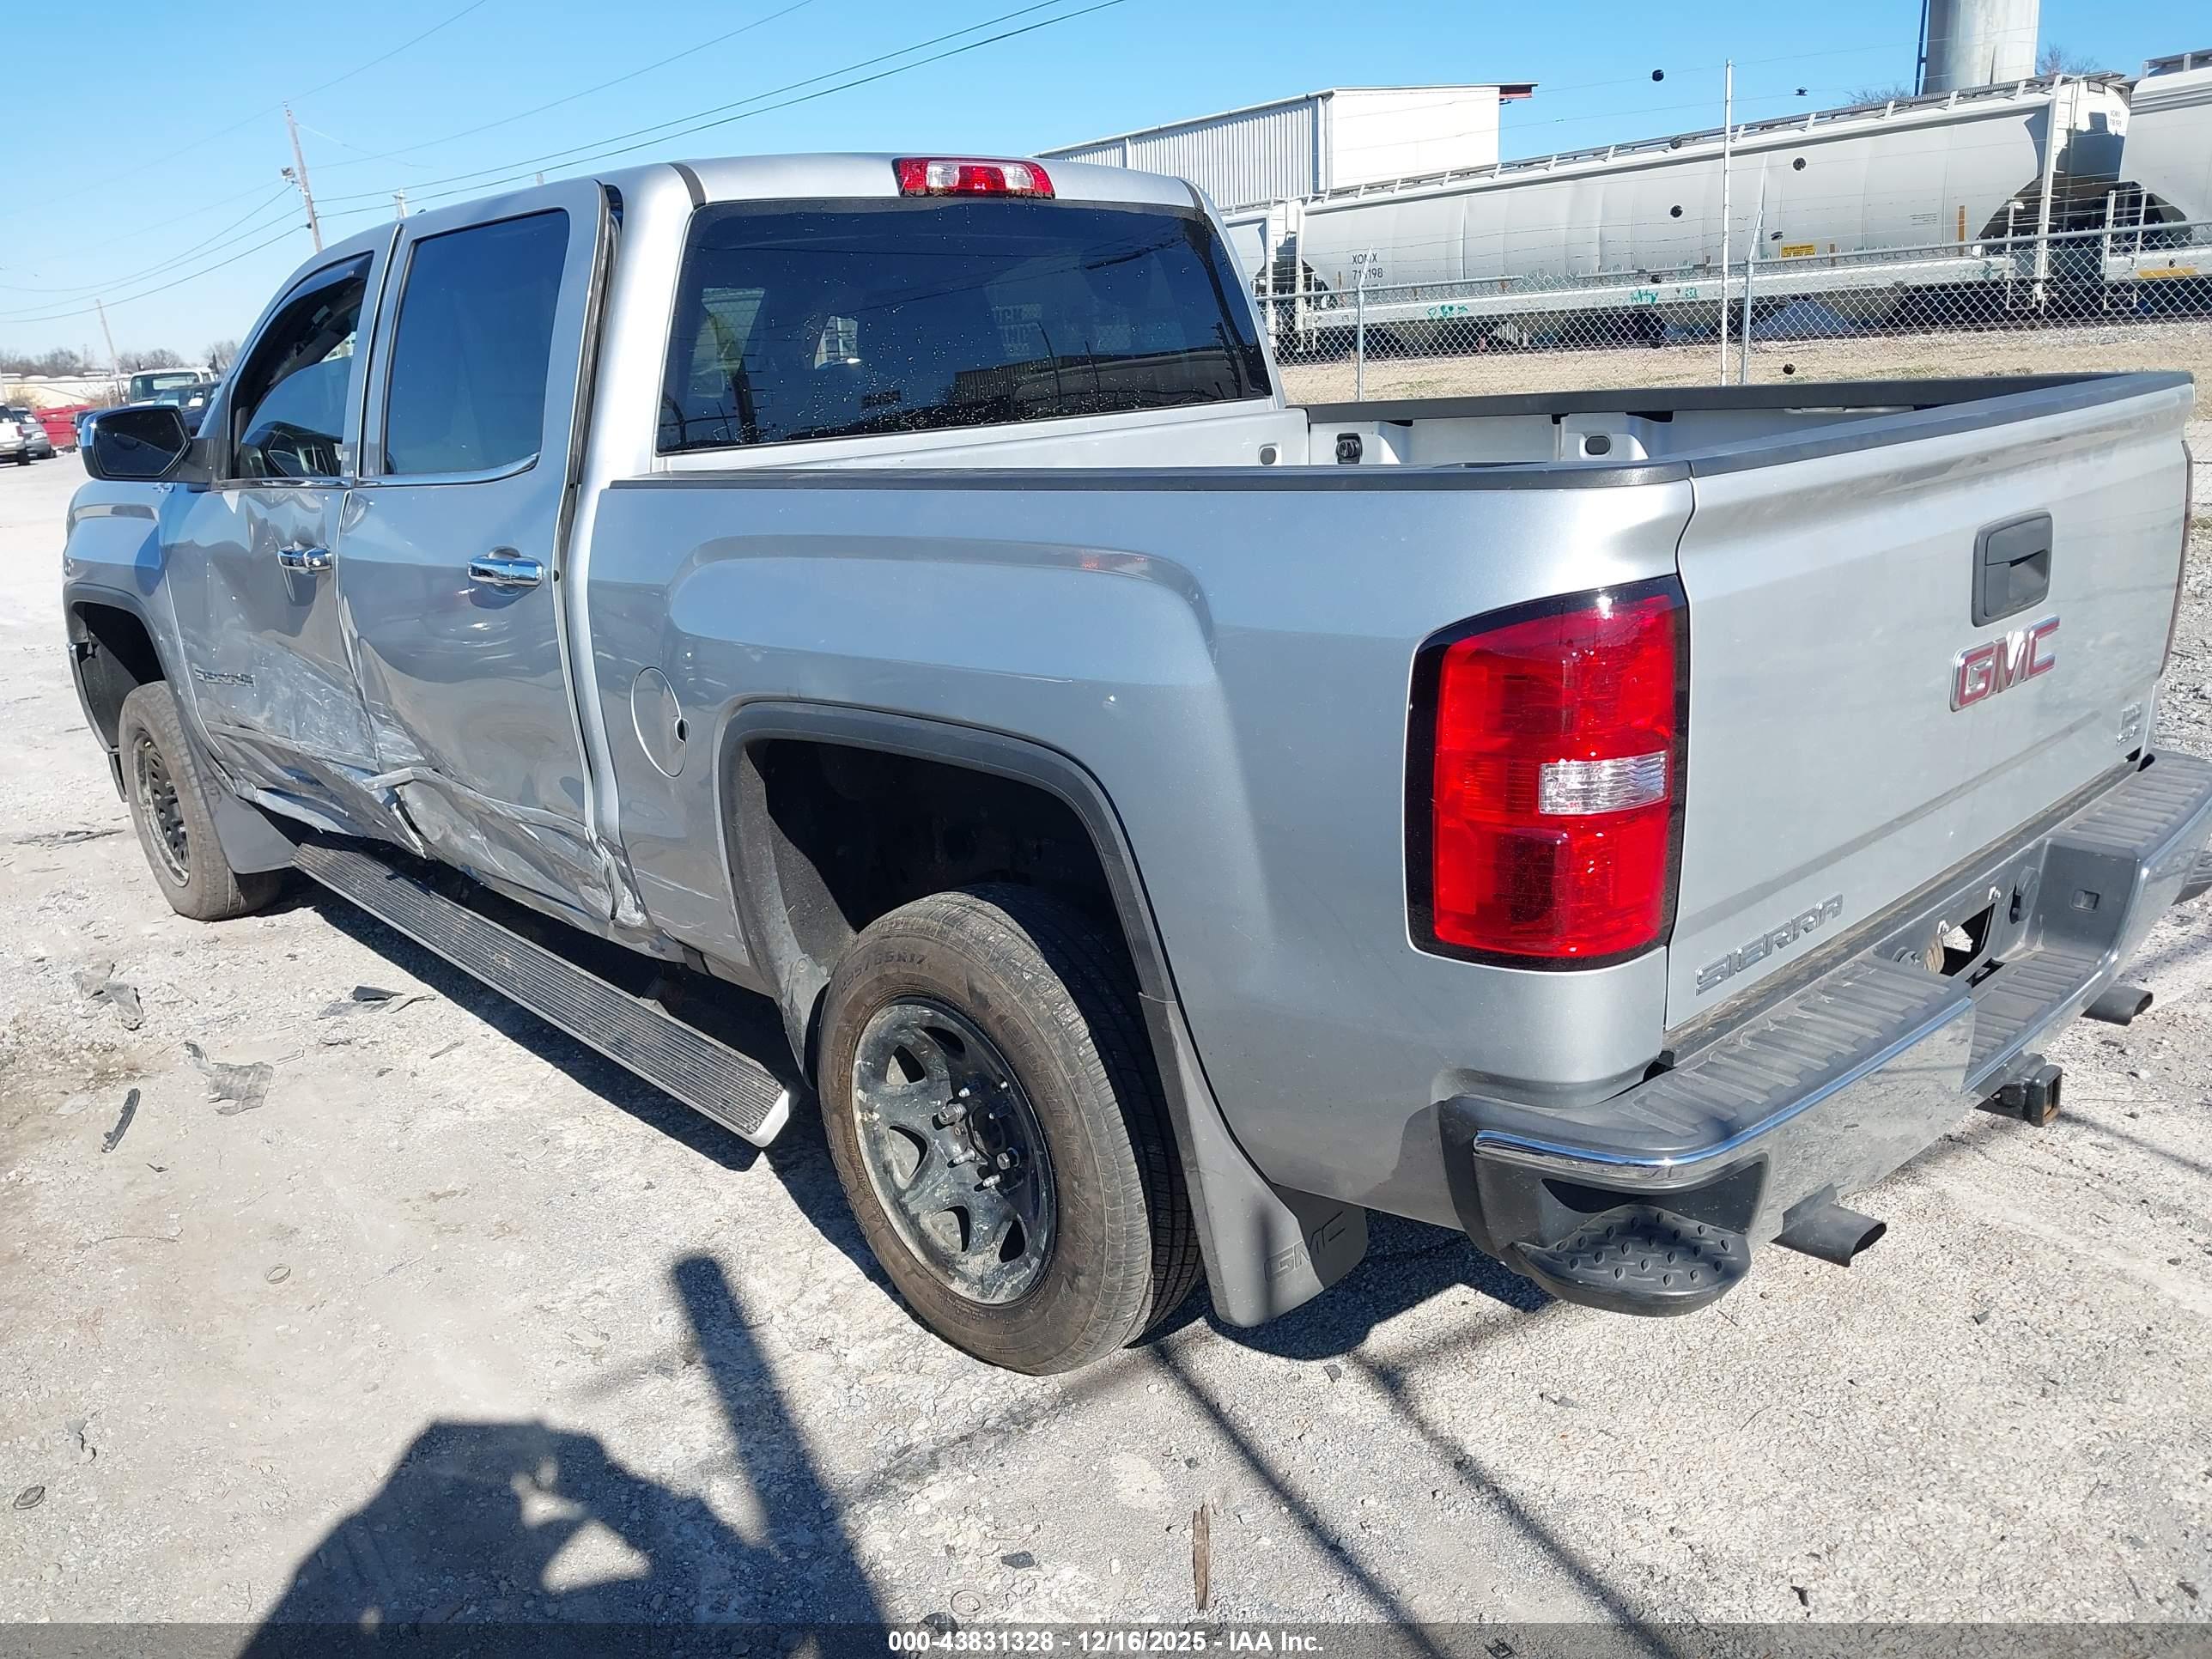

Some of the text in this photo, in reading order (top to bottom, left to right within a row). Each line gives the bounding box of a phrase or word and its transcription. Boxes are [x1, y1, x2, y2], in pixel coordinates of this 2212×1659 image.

[1950, 613, 2061, 712] GMC
[1695, 891, 1844, 996] SIERRA
[1263, 1210, 1346, 1282] GMC
